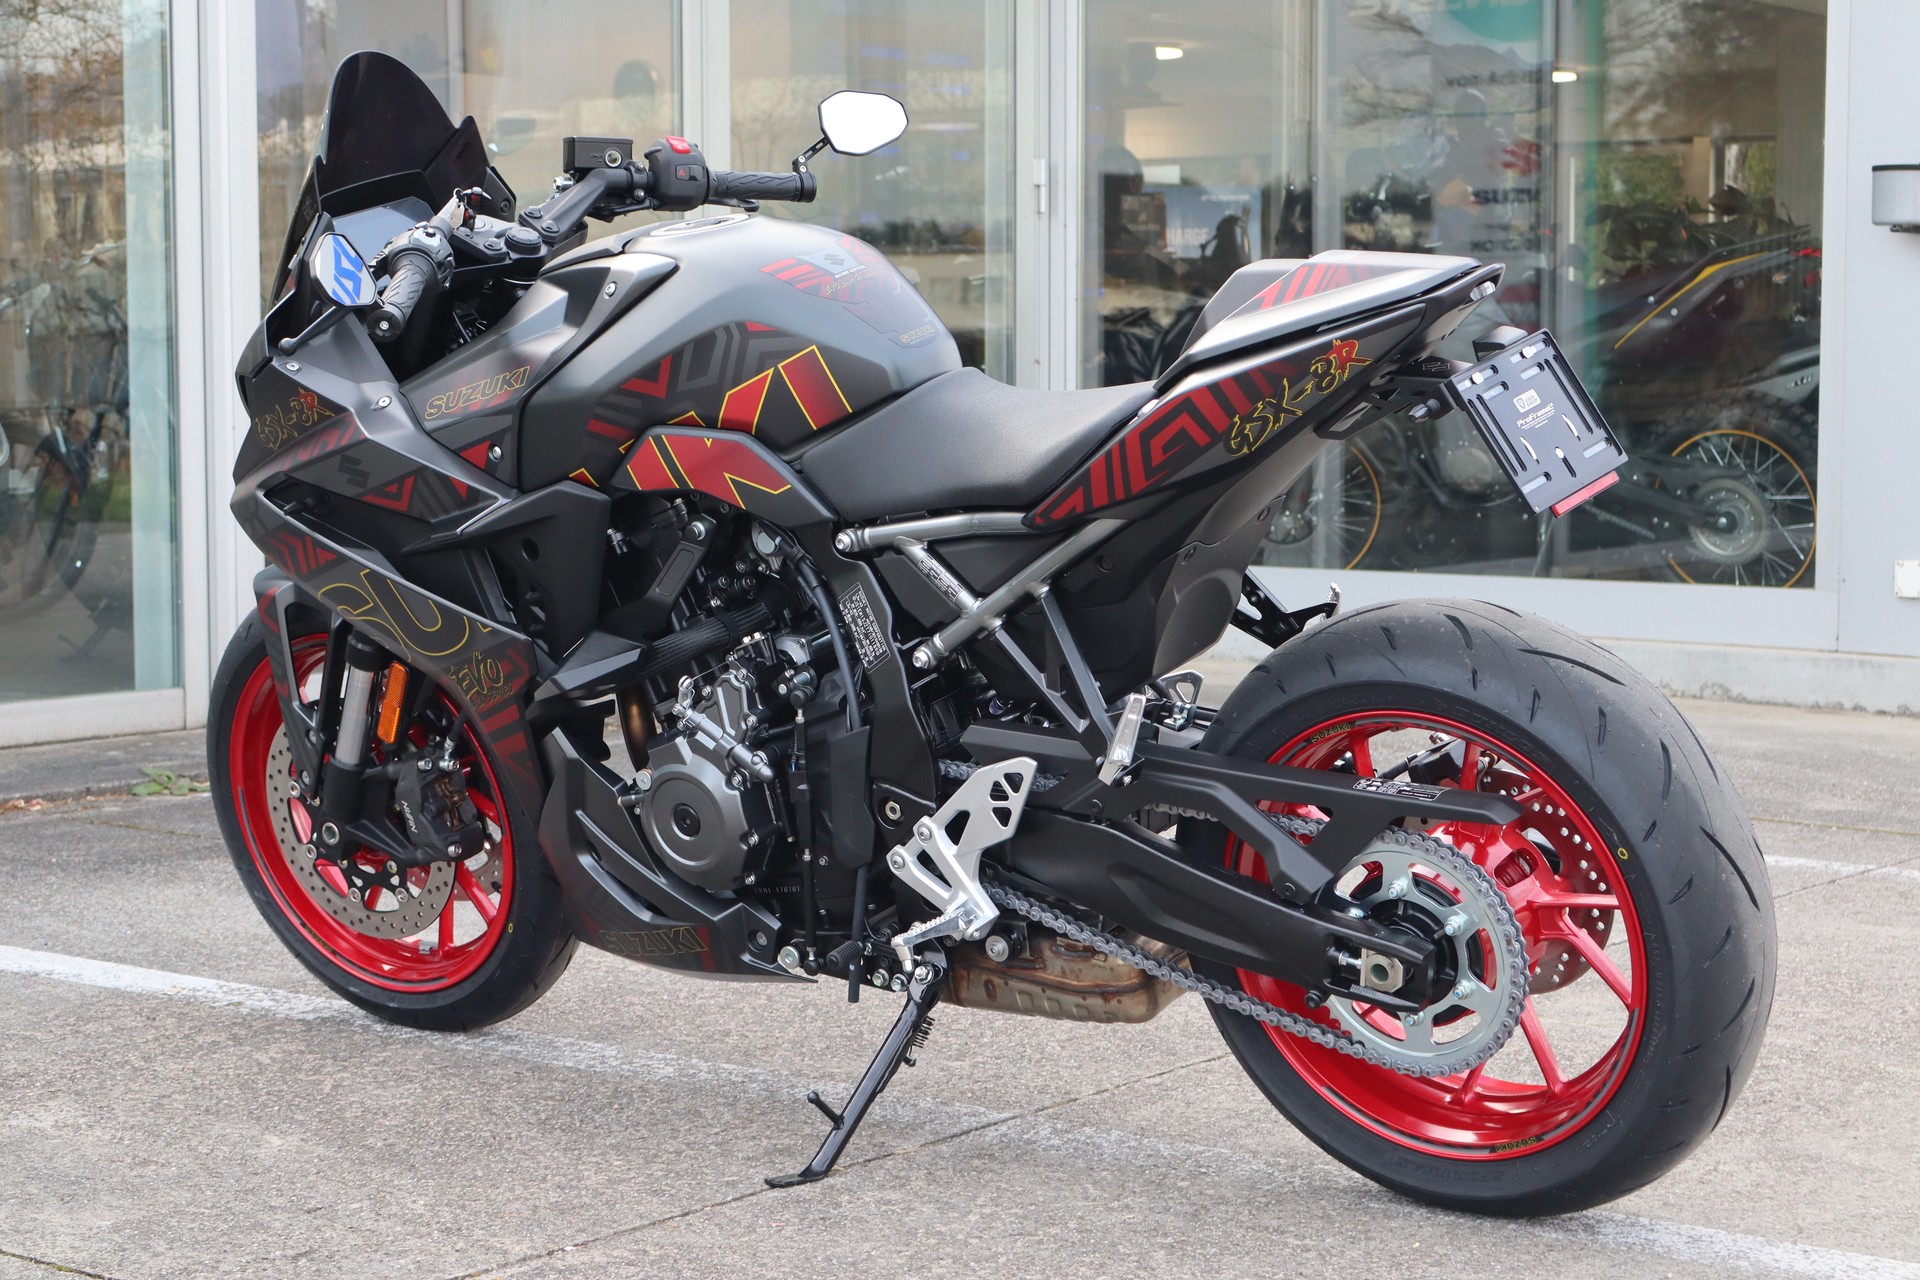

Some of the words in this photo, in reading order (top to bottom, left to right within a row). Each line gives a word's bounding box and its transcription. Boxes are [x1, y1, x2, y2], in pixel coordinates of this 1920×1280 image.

[424, 365, 531, 419] SUZUKI
[448, 650, 505, 701] EVO
[1311, 721, 1352, 743] SUZUKI
[598, 926, 709, 957] SUZUKI
[1494, 1136, 1538, 1153] SUZUKI
